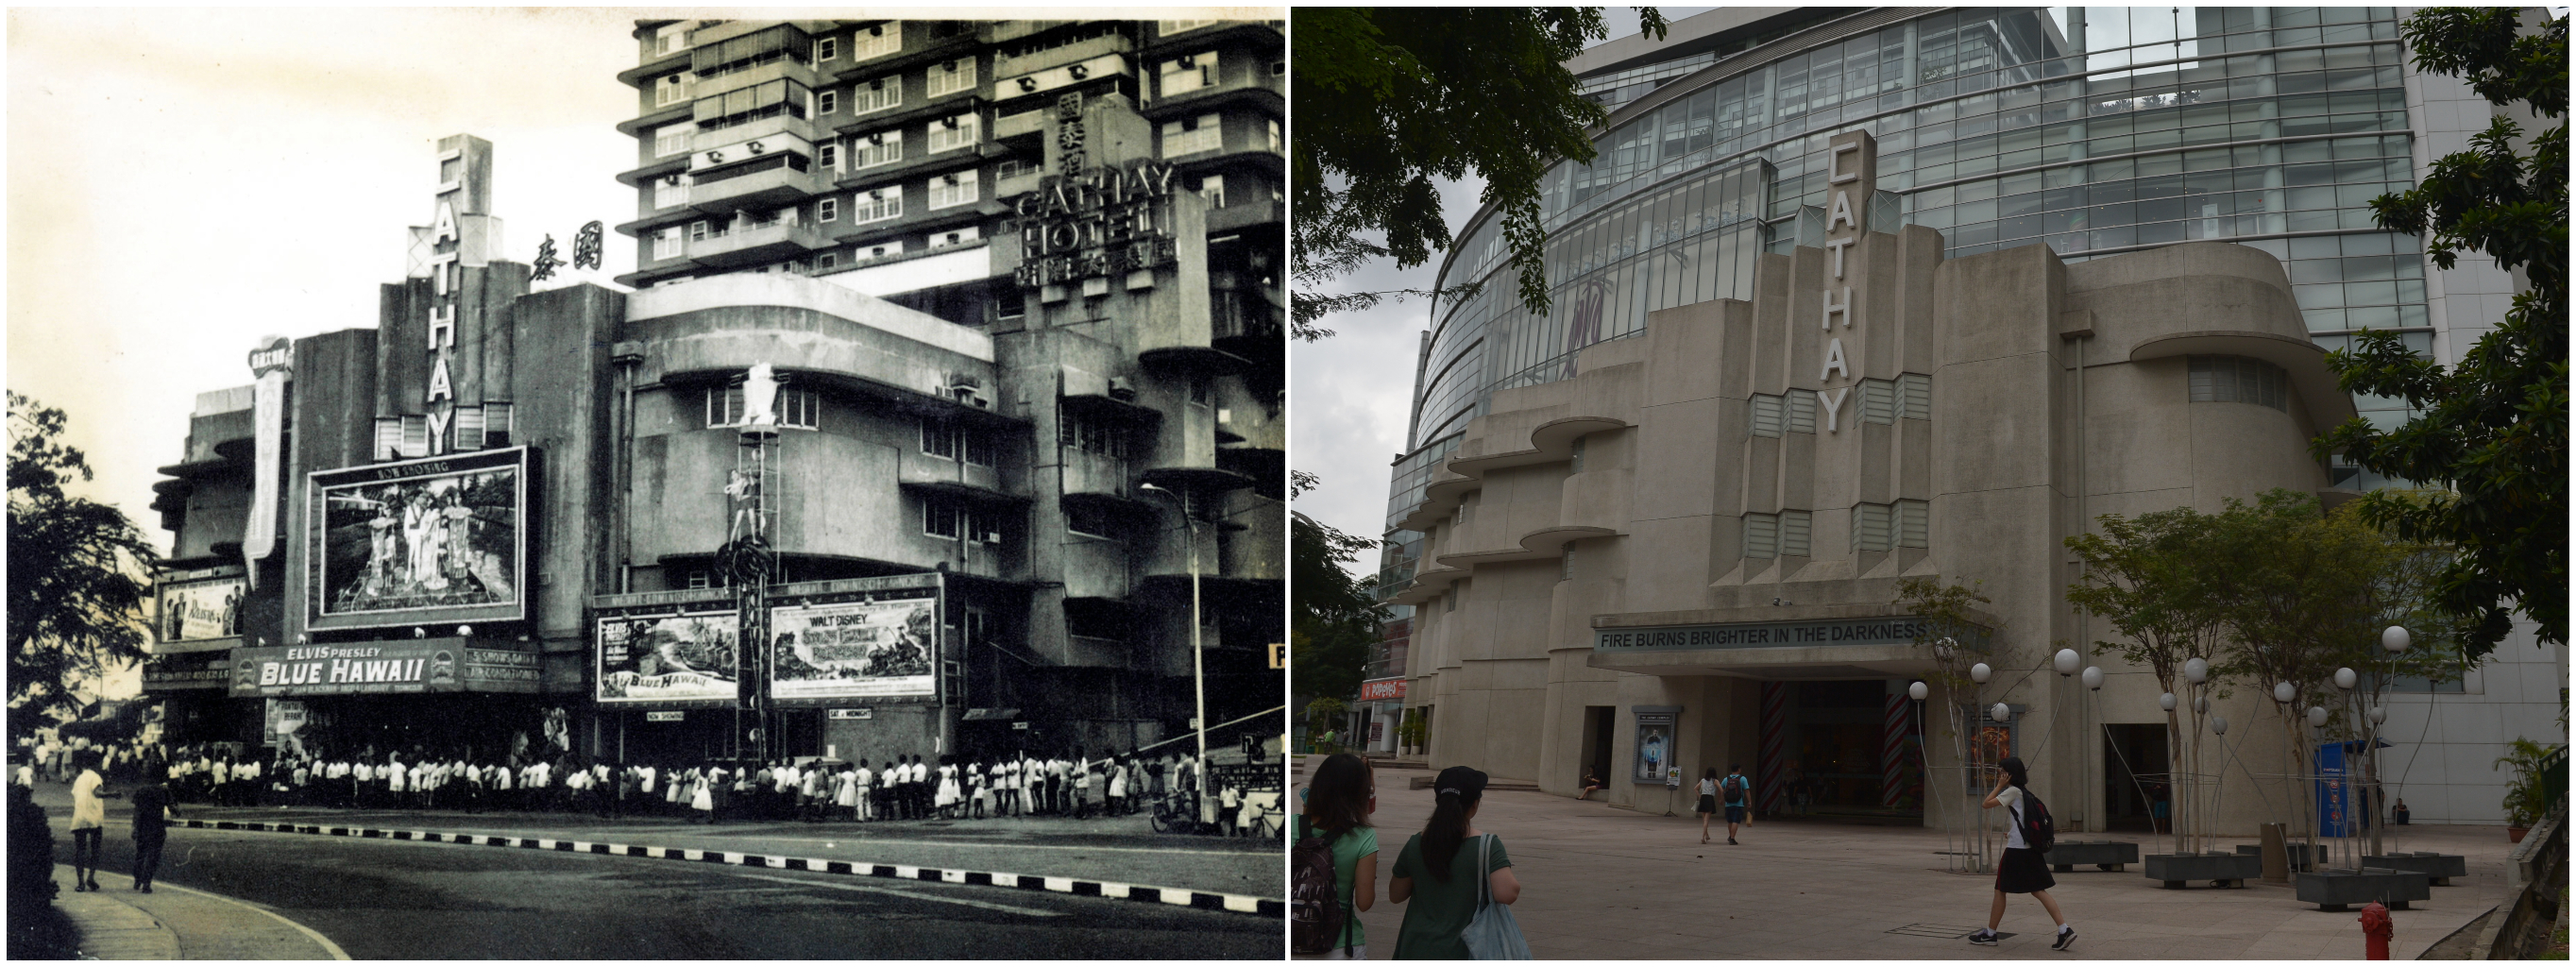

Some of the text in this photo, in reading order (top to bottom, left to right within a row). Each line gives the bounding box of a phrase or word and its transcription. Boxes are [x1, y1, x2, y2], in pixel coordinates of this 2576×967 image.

[1017, 161, 1175, 219] CATHAY
[1024, 195, 1176, 259] HOTEL
[1817, 141, 1858, 433] CATHAY
[427, 148, 463, 455] CATHAY
[379, 462, 449, 480] NOW SHOWING
[606, 622, 628, 634] ELVIS
[809, 614, 868, 627] WALT DISNEY
[1601, 622, 1927, 648] FIRE BURNS BRIGHTER IN THE DARKNESS
[287, 647, 330, 661] ELVIS
[330, 647, 381, 659] PRESLEY
[260, 658, 426, 686] BLUE HAWAII
[631, 674, 660, 687] BLUE
[846, 709, 871, 718] MIDNIGHT
